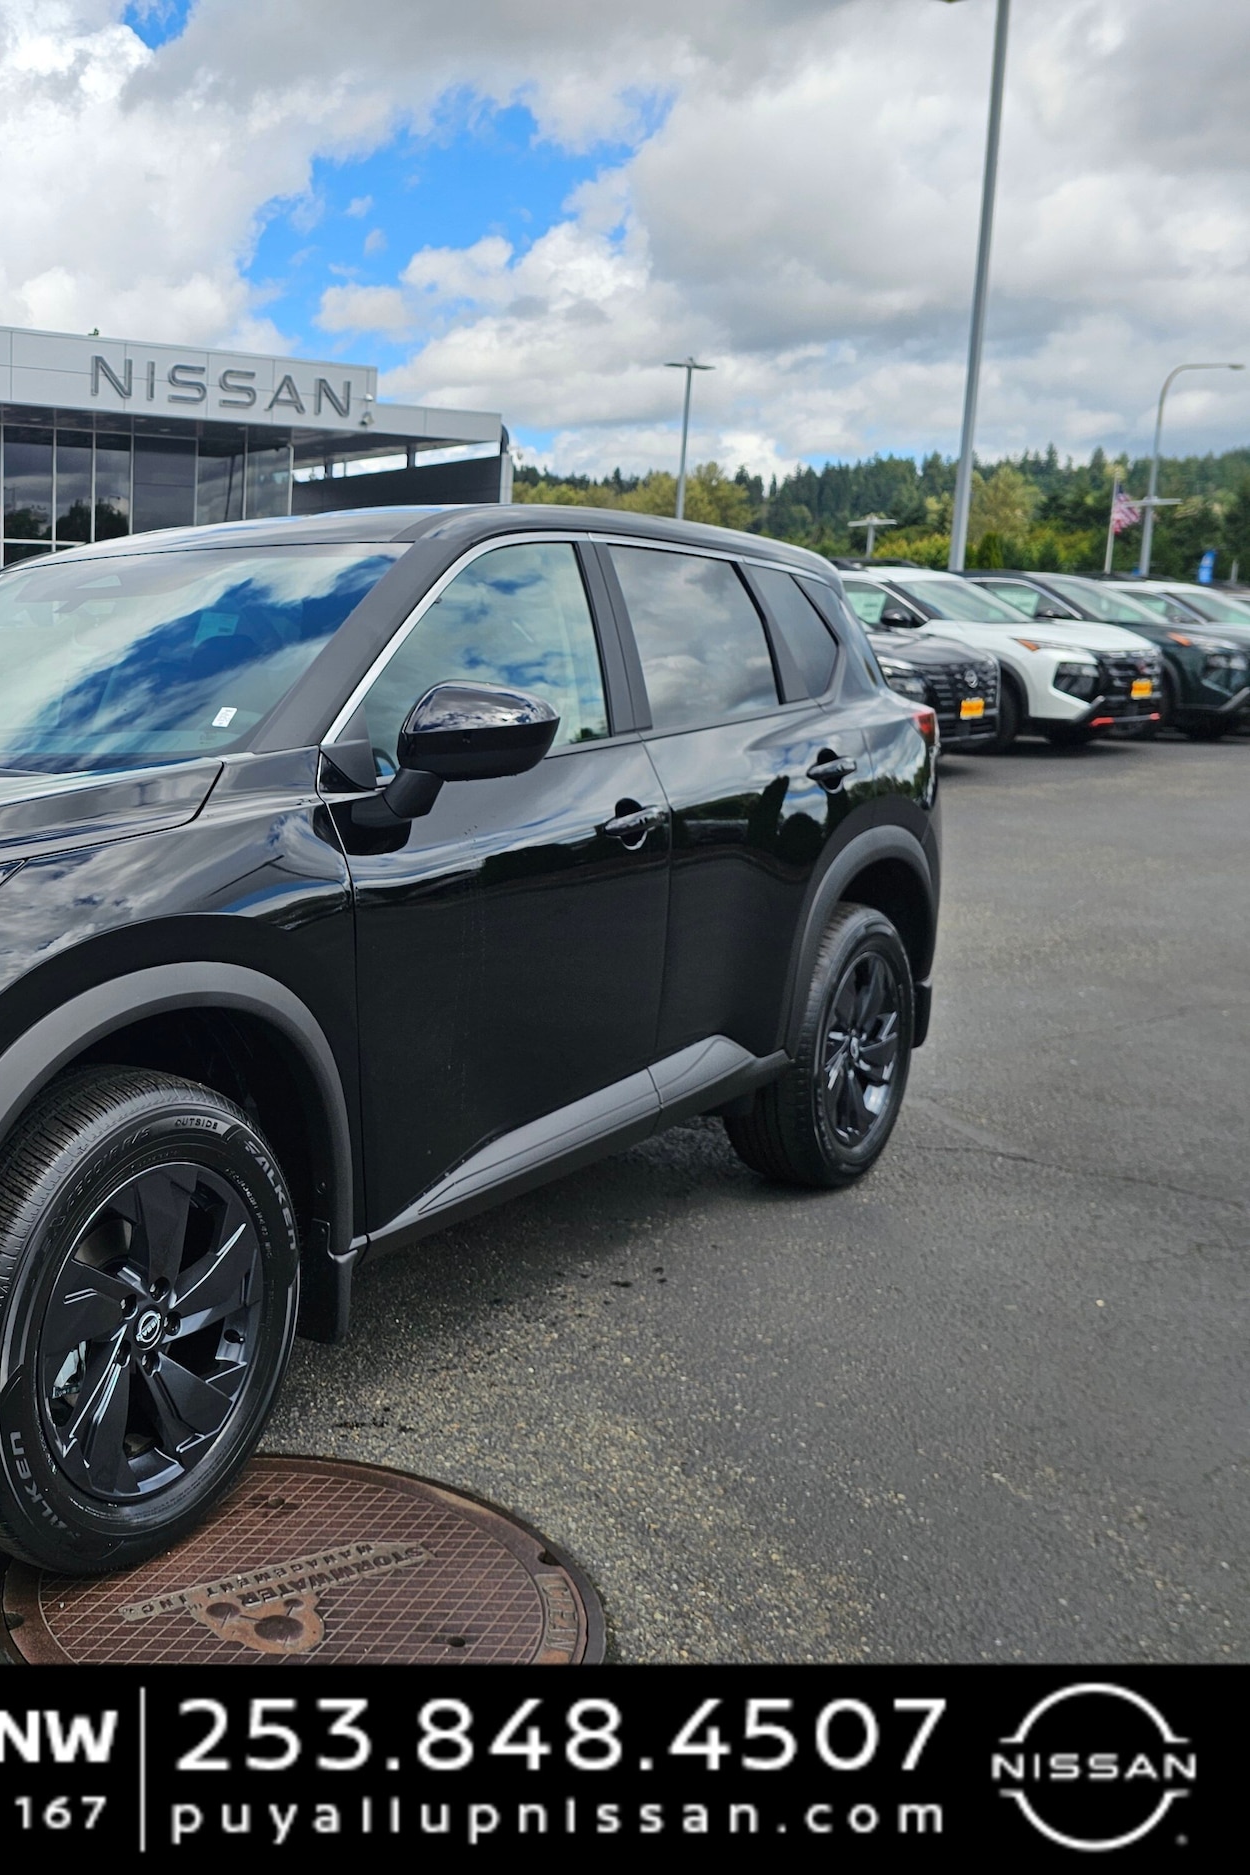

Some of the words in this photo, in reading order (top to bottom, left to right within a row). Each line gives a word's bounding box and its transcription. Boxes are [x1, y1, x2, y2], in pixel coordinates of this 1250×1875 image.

[90, 355, 352, 418] NISSAN
[174, 1117, 219, 1130] OUTSIDE
[244, 1139, 297, 1250] FALKEN
[205, 1542, 374, 1598] MANAGEMENT
[241, 1547, 424, 1608] STORMWATER
